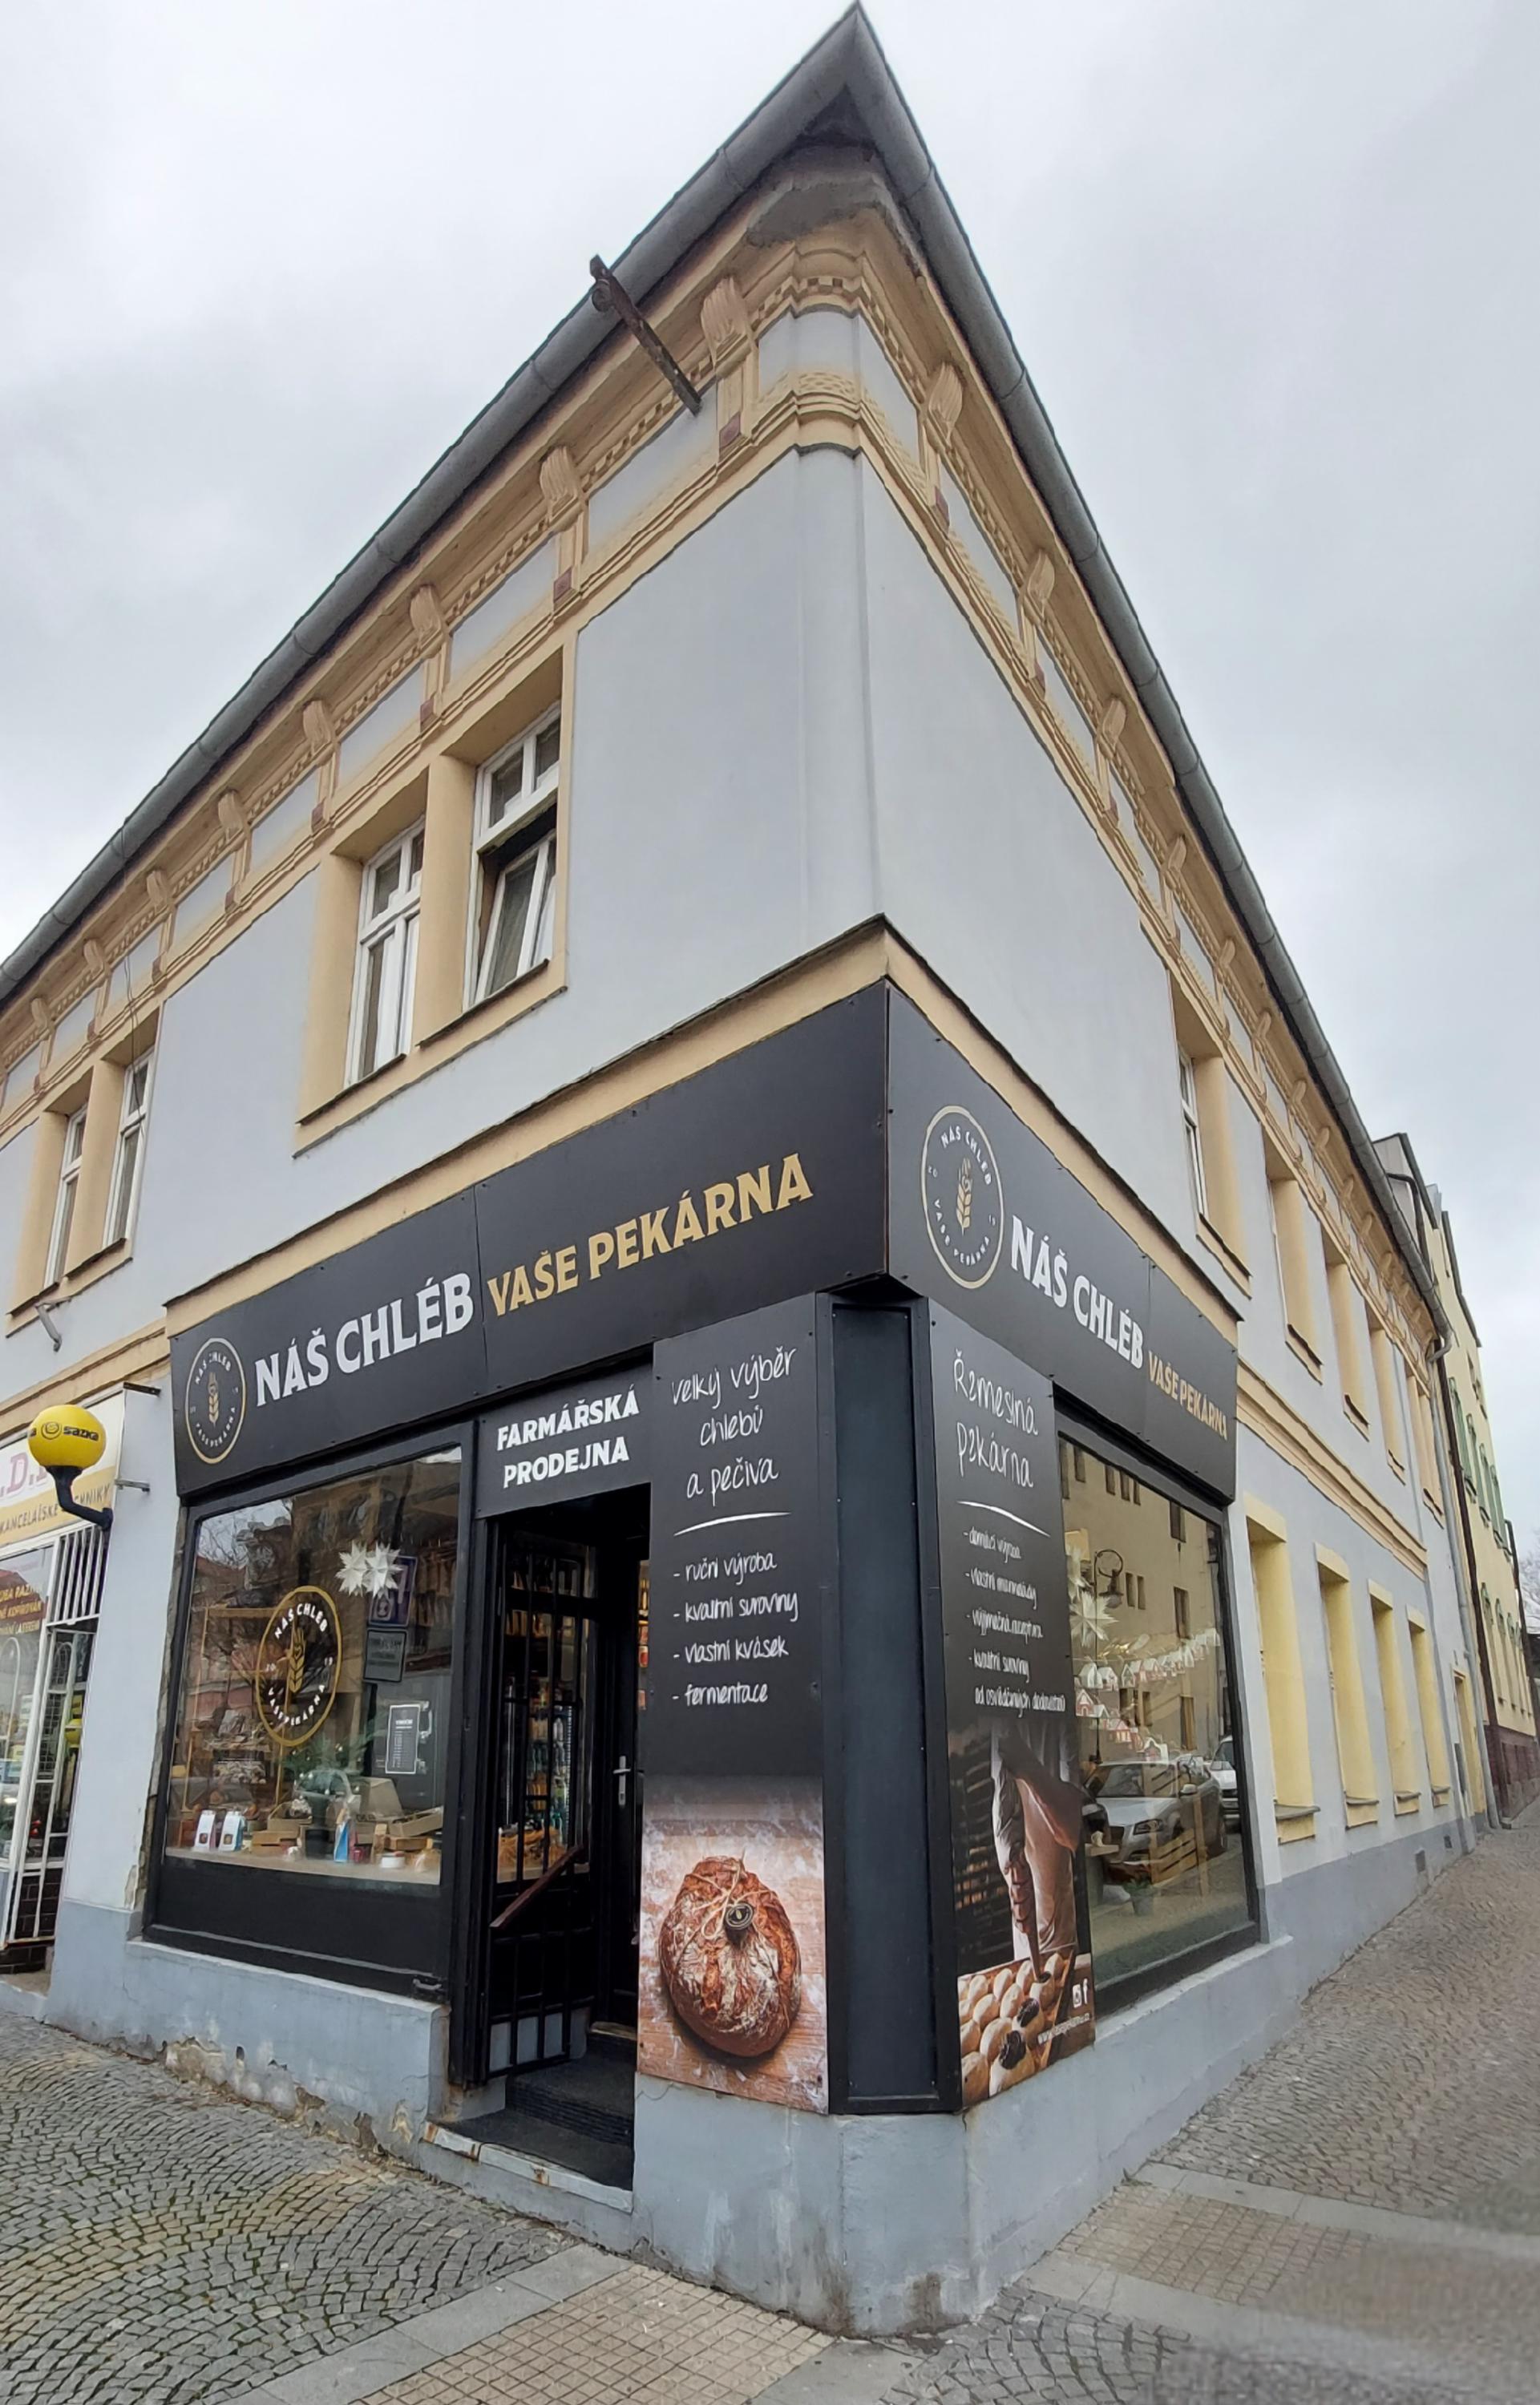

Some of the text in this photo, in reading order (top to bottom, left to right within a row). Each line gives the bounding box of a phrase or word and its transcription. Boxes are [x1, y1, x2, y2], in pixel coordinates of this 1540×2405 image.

[487, 1153, 814, 1316] VAŠE PEKÁRNA
[255, 1272, 474, 1407] NÁŠ CHLÉB
[1011, 1214, 1228, 1441] NÁŠ CHLÉB VAŠE PEKÁRNA
[672, 1346, 797, 1409] velký výběr
[954, 1348, 1039, 1436] Řemeslná
[497, 1384, 640, 1451] FARMÁŘSKÁ
[700, 1405, 763, 1446] chlebů
[503, 1436, 630, 1489] PRODEJNA
[687, 1457, 779, 1507] a pečiva
[685, 1552, 778, 1586] ruční výroba
[685, 1592, 798, 1623] kvalitní suroviny
[685, 1635, 790, 1663] vlastní kvásek
[685, 1681, 769, 1706] fermentace
